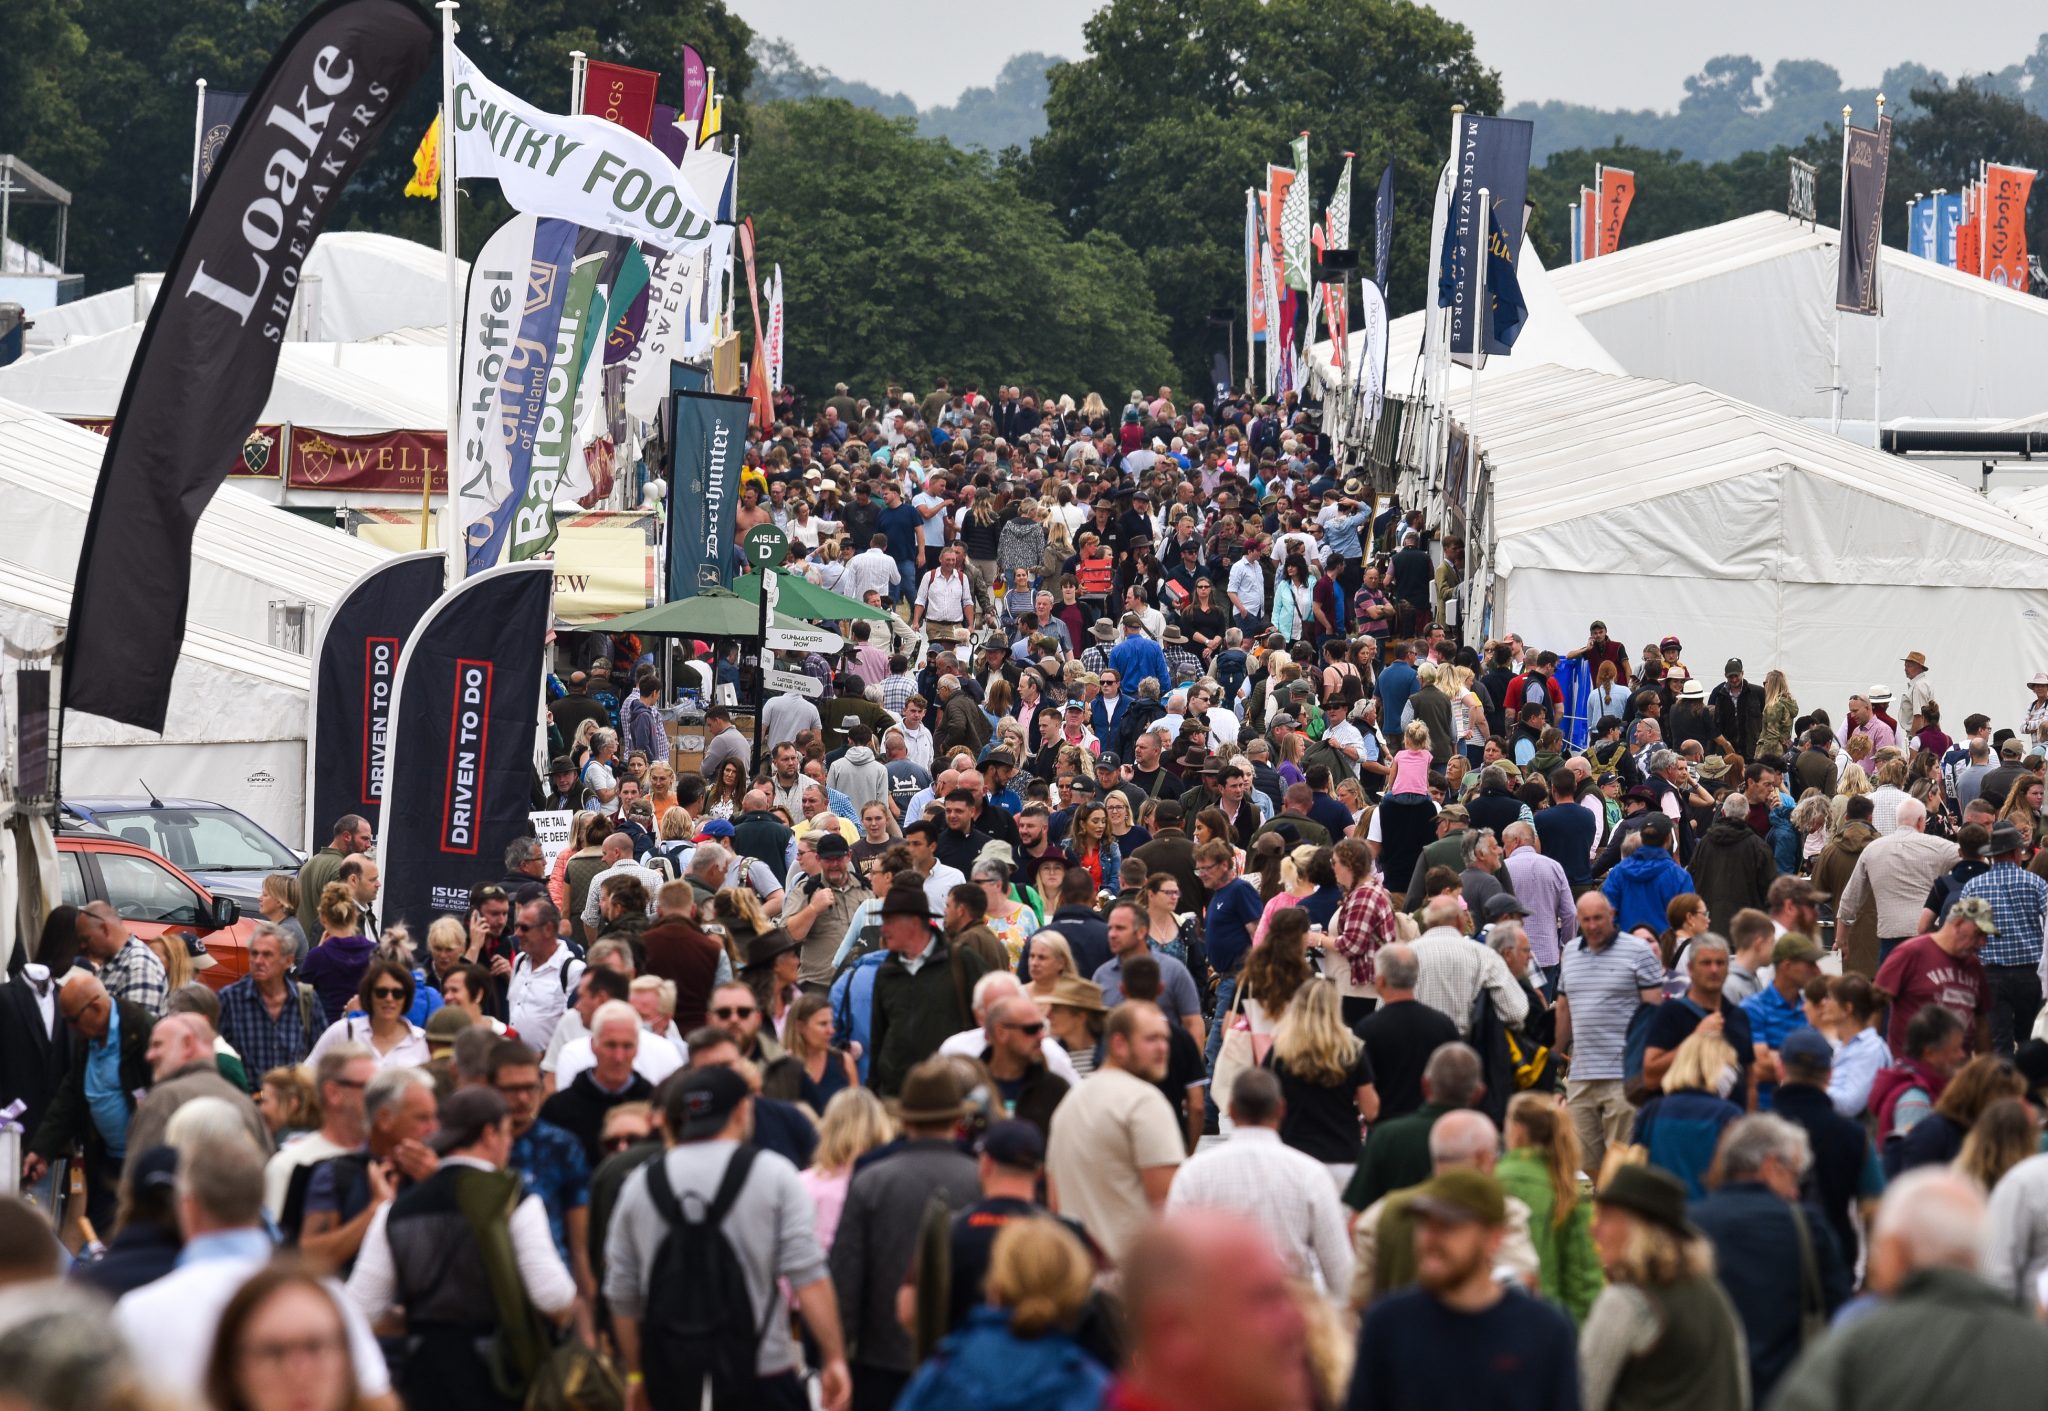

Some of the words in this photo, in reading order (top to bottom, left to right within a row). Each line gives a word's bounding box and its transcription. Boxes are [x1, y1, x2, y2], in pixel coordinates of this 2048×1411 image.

[185, 45, 354, 327] Loake
[582, 150, 712, 241] FOOD
[1460, 122, 1479, 236] MACKENZIE
[263, 81, 390, 343] SHOEMAKERS
[1606, 184, 1626, 254] ubota
[1992, 180, 2011, 260] Kubota
[651, 256, 693, 355] SWEDE
[521, 366, 545, 425] Ireland
[514, 316, 580, 547] Barbour
[520, 430, 533, 450] of
[399, 476, 445, 484] DISTCT
[705, 422, 730, 559] Deerhunter
[752, 535, 781, 544] AISLE
[759, 545, 772, 559] D
[553, 575, 590, 593] EW
[781, 634, 823, 642] GUNMAKERS
[374, 645, 390, 675] DO
[373, 681, 388, 710] TO
[464, 668, 483, 704] DO
[460, 711, 479, 745] TO
[370, 717, 387, 796] DRIVEN
[451, 752, 475, 844] DRIVEN
[535, 818, 550, 828] THE
[552, 817, 567, 827] TAIL
[550, 832, 569, 842] DEER
[1926, 967, 1955, 985] VAN
